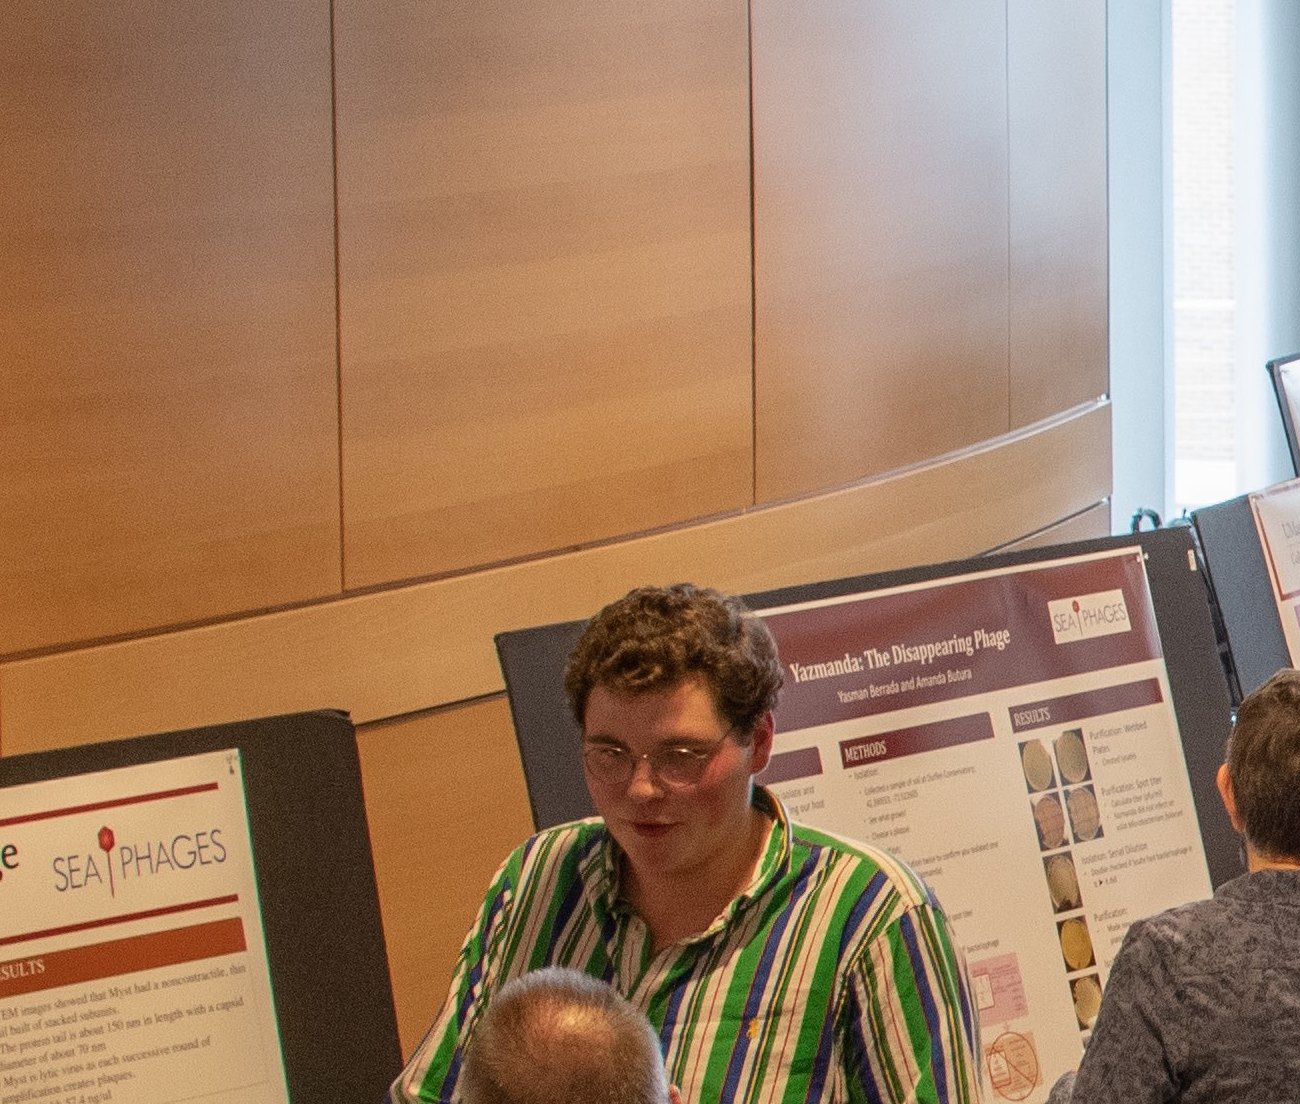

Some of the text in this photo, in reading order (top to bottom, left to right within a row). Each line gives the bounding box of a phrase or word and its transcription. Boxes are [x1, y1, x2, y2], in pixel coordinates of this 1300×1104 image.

[1053, 602, 1127, 633] SEA PHAGES
[788, 628, 1010, 684] Yazmanda: The Disappearing Phage
[837, 670, 972, 705] Yasman Berrada and Amanda Butura
[1014, 706, 1051, 726] RESULTS
[844, 739, 887, 763] METHODS
[0, 844, 19, 882] e
[53, 829, 228, 892] SEA PHAGES
[0, 957, 46, 980] SULTS
[0, 1007, 18, 1020] EM
[21, 1003, 50, 1016] images
[54, 993, 87, 1009] showed
[90, 990, 106, 1002] that
[108, 985, 132, 1000] Myst
[134, 981, 150, 993] had
[229, 963, 246, 974] thin
[0, 1042, 16, 1054] The
[19, 1036, 50, 1052] protein
[52, 1031, 66, 1043] tail
[69, 1031, 76, 1040] is
[79, 1025, 104, 1038] about
[106, 1020, 123, 1032] 150
[126, 1019, 140, 1028] nm
[143, 1016, 152, 1025] in
[154, 1008, 183, 1023] length
[185, 1003, 206, 1017] with
[215, 996, 244, 1011] capsid
[10, 1022, 30, 1035] built
[32, 1019, 42, 1030] of
[44, 1012, 77, 1028] stacked
[4, 1074, 26, 1088] Myst
[28, 1073, 36, 1082] is
[39, 1068, 58, 1082] lytic
[86, 1062, 94, 1071] as
[98, 1055, 119, 1068] each
[121, 1047, 170, 1064] successive
[172, 1039, 198, 1053] round
[200, 1036, 210, 1048] of
[38, 1051, 48, 1063] of
[50, 1047, 74, 1060] about
[76, 1043, 88, 1055] 70
[90, 1043, 106, 1052] nm
[1, 1086, 61, 1104] amplification
[62, 1079, 94, 1092] creates
